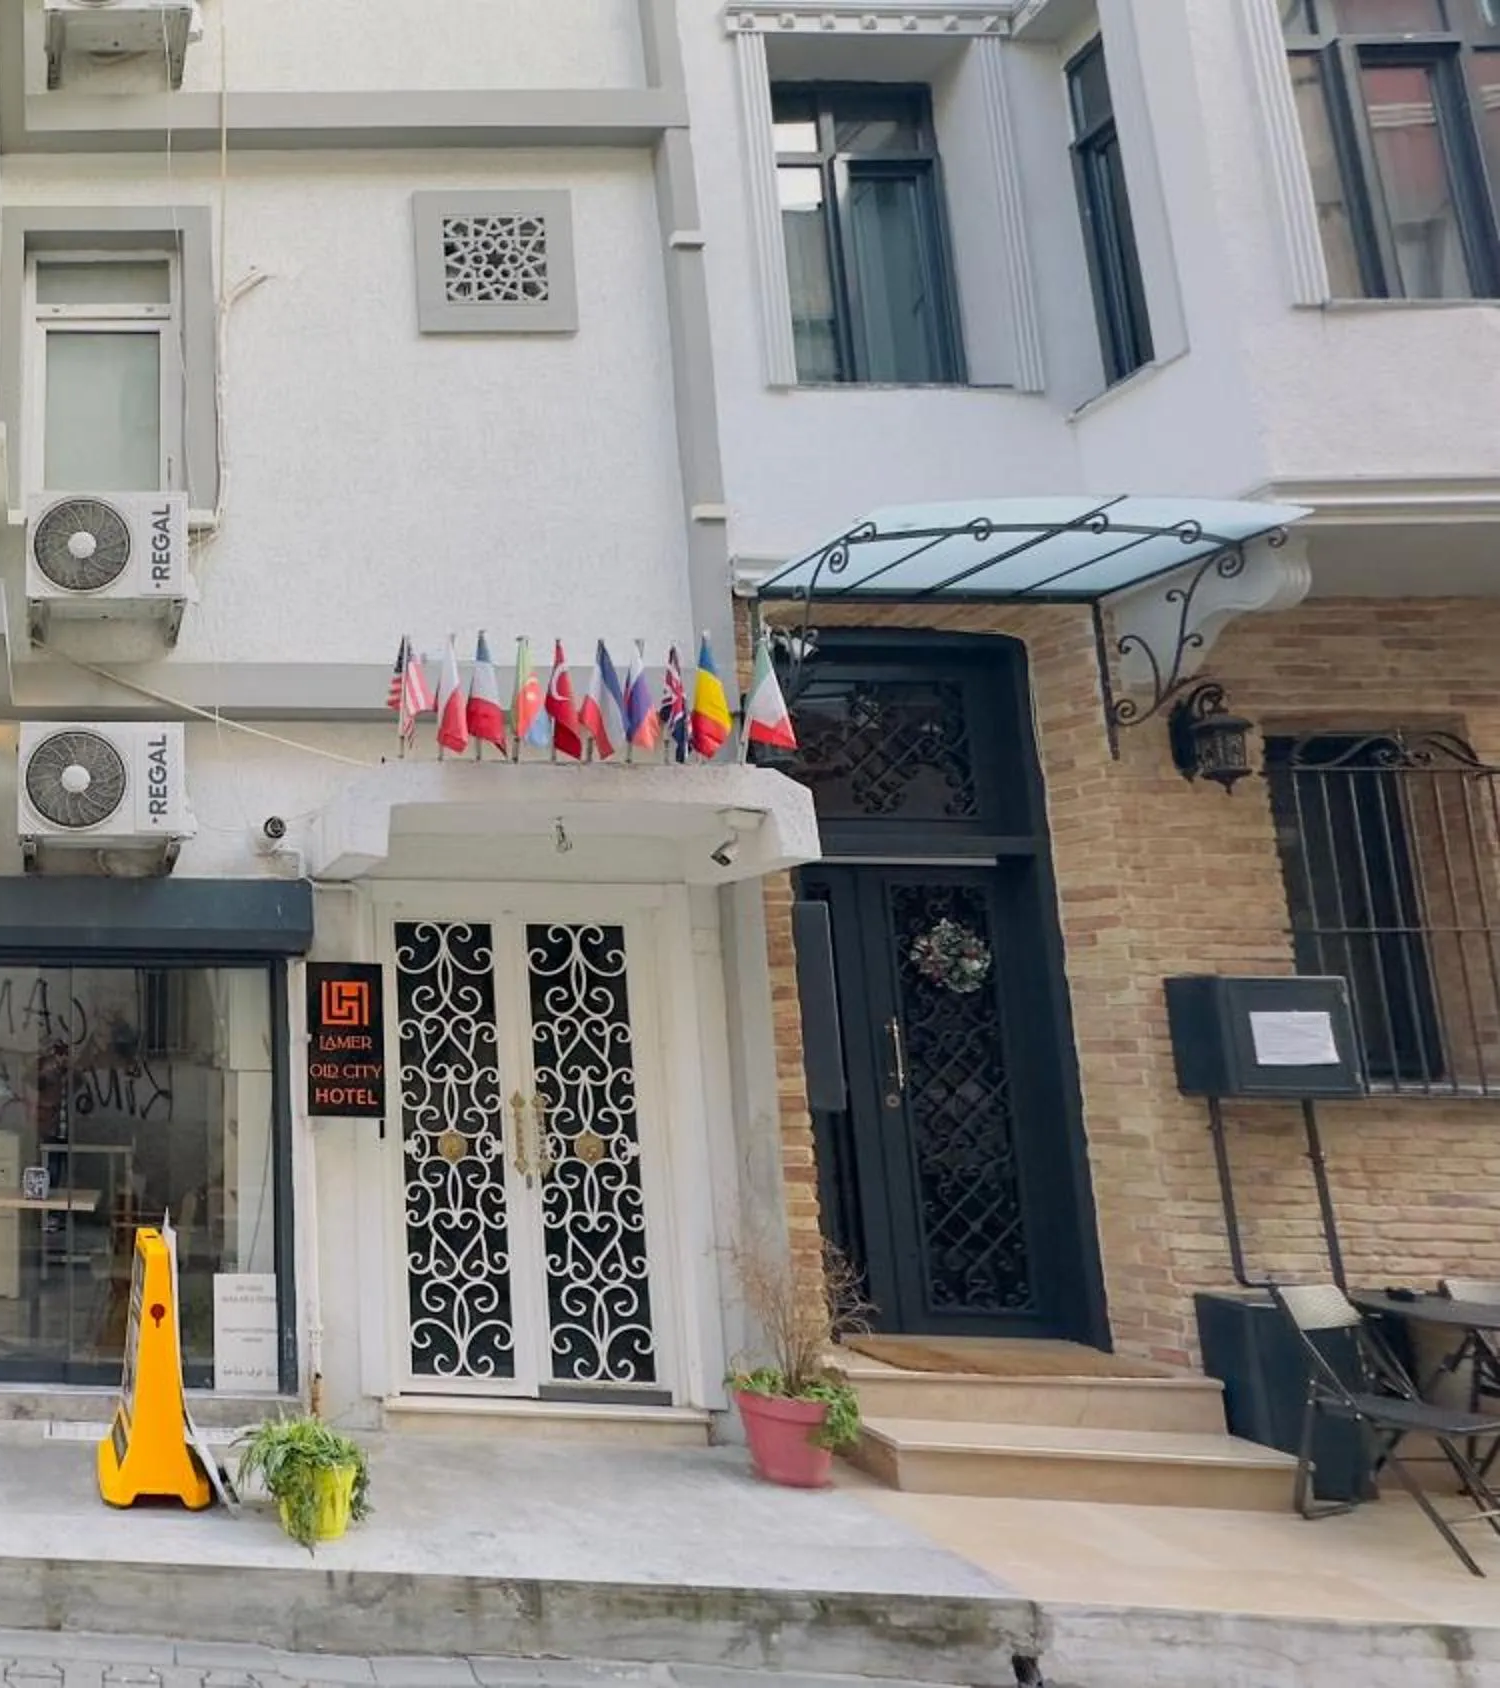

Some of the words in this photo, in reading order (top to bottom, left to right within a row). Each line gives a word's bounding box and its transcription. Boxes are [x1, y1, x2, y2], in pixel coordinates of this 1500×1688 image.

[151, 503, 171, 581] REGAL
[147, 733, 168, 815] REGAL
[319, 1034, 373, 1051] LAMER
[309, 1063, 339, 1079] OLD
[343, 1064, 383, 1080] CITY
[315, 1087, 379, 1105] HOTEL
